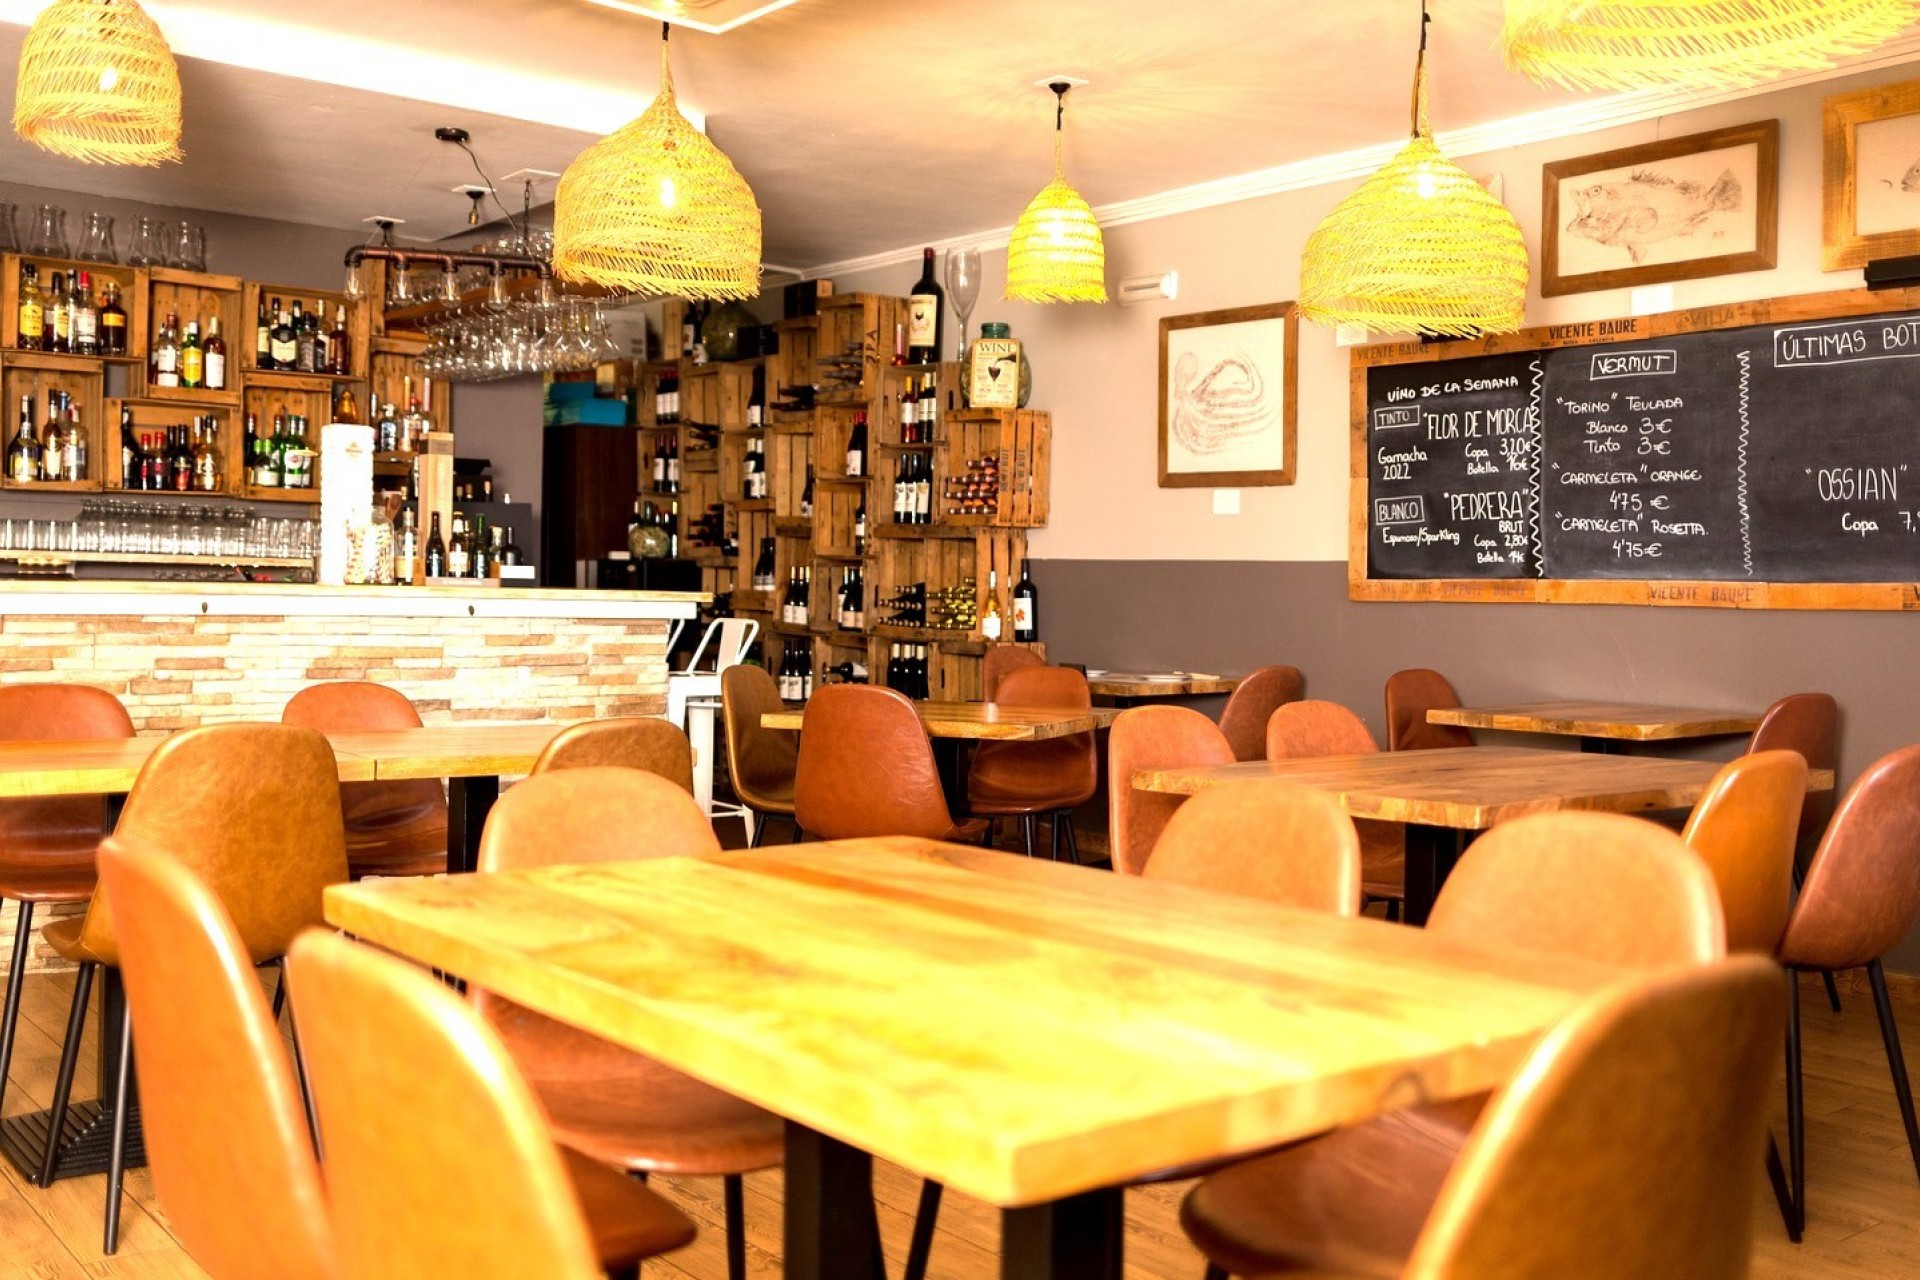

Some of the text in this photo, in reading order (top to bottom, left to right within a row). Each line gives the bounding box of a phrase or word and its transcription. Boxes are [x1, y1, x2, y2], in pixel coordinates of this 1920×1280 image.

[1549, 318, 1638, 340] VICENTE BAURE
[1782, 329, 1866, 361] ÚLTIMAS
[1597, 354, 1671, 375] VERMUT
[1387, 375, 1519, 402] VINO DE LA SEMANA
[1378, 410, 1411, 426] TINTO
[1464, 410, 1483, 438] DE
[1585, 420, 1629, 435] Blanco
[1465, 442, 1490, 463] Copa
[1582, 436, 1622, 454] Tinto
[1377, 446, 1428, 464] Garnacha
[1382, 462, 1412, 480] 2022
[1466, 460, 1499, 476] Botella
[1650, 469, 1703, 482] ORANGE
[1378, 501, 1420, 522] BLANCO
[1498, 520, 1525, 534] BRUT
[1841, 511, 1880, 538] Copa
[1473, 533, 1498, 551] Copa
[1477, 551, 1505, 564] Botella
